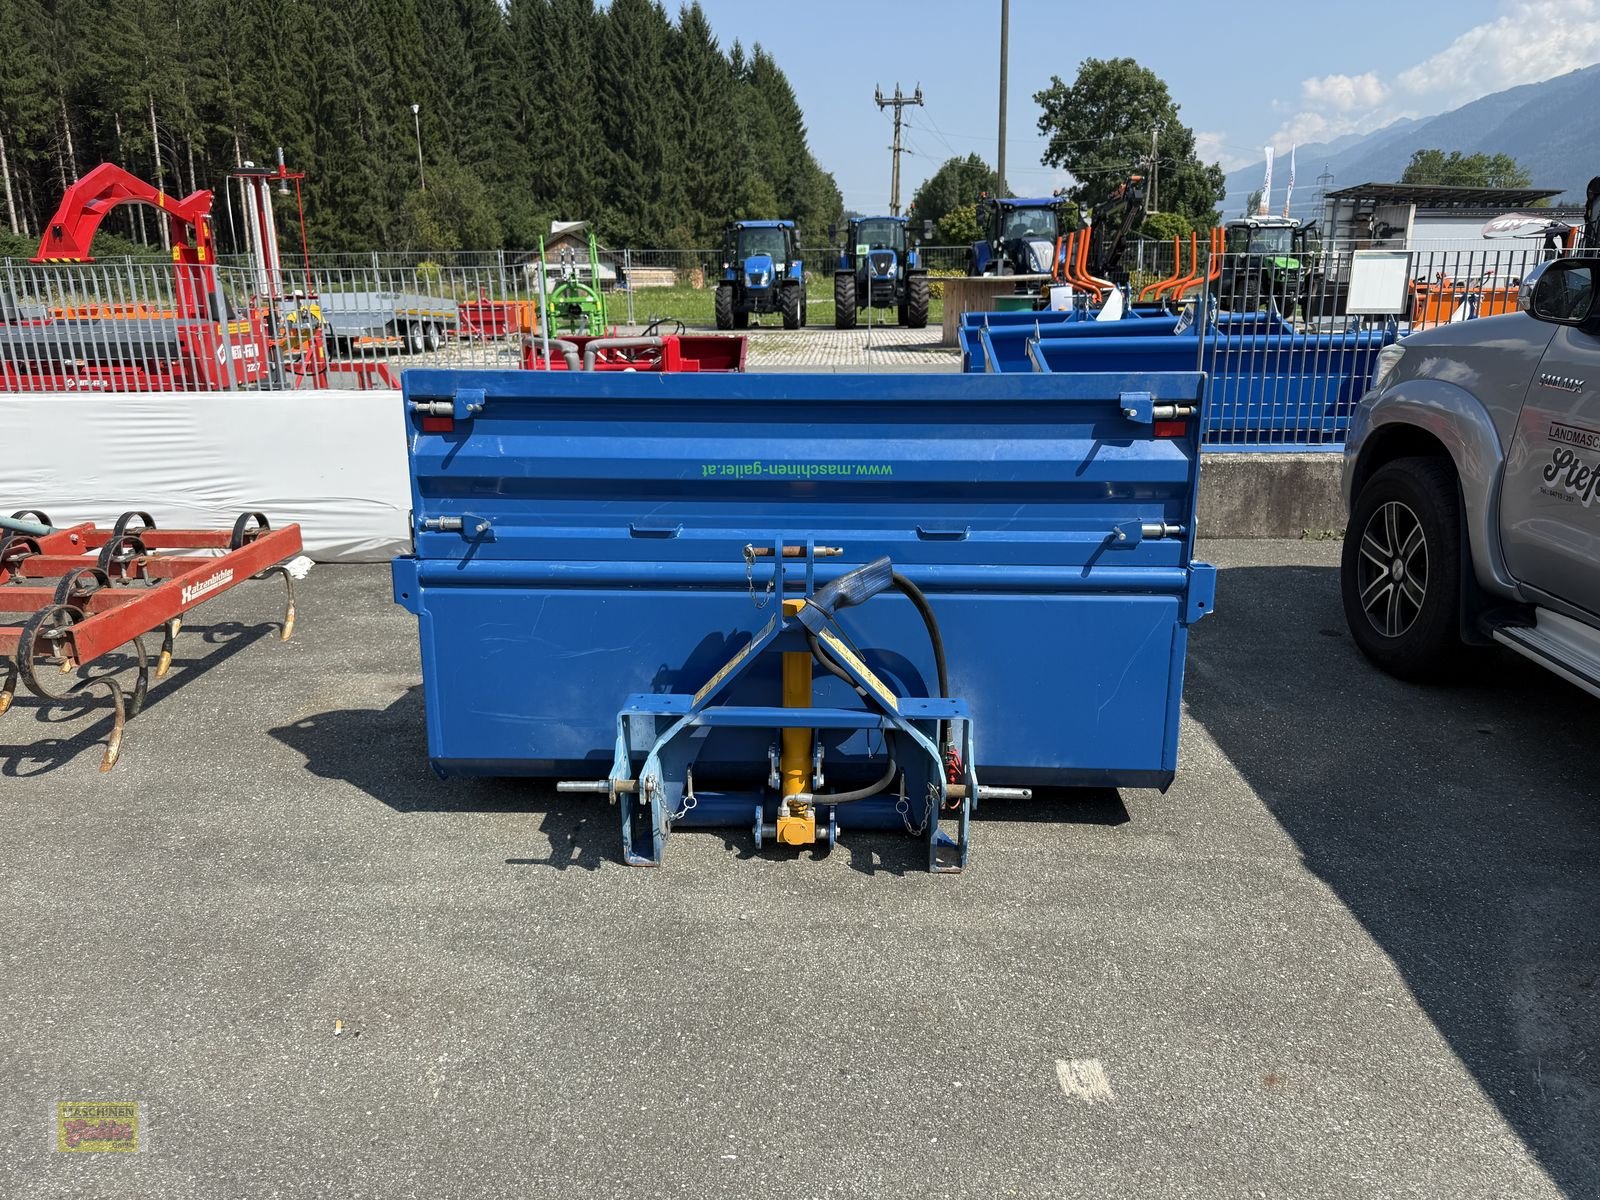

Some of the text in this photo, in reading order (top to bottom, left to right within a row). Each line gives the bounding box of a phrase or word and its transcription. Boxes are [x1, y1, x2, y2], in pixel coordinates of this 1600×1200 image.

[1539, 373, 1585, 393] HILUX
[1548, 426, 1600, 448] LANDMASC
[702, 461, 893, 478] www.maschinen-gailer.at
